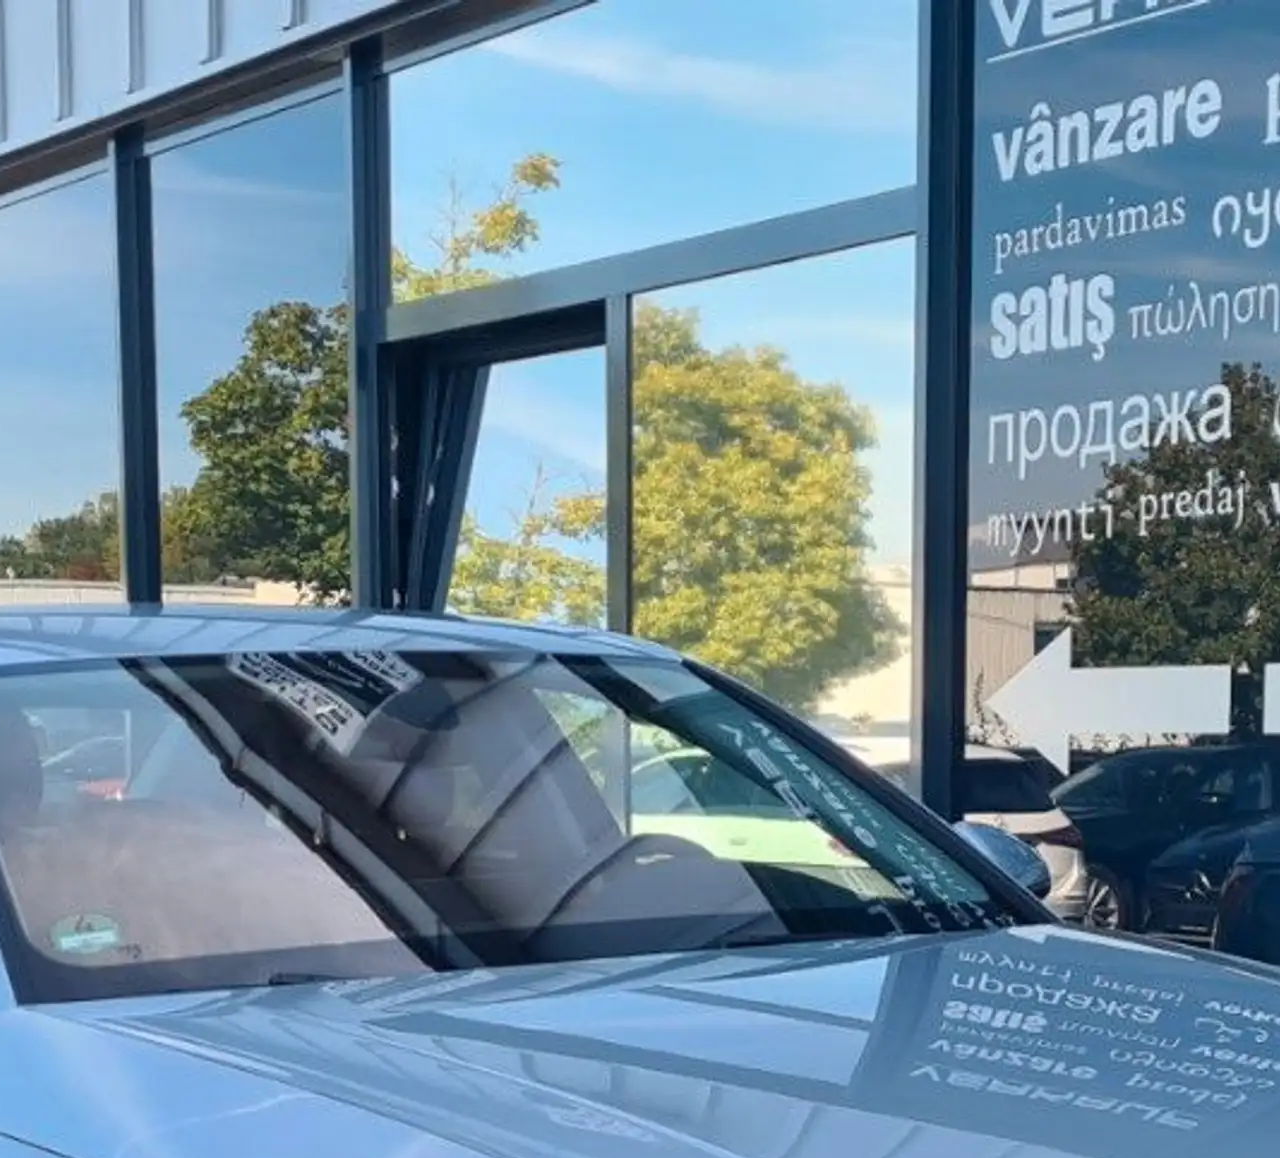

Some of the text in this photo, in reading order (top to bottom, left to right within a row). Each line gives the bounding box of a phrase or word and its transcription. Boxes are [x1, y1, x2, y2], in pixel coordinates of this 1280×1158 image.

[992, 78, 1222, 181] vânzare
[993, 196, 1187, 274] pardavimas
[989, 272, 1116, 361] satış
[1128, 281, 1280, 341] πώληση
[987, 383, 1232, 481] продажа
[986, 493, 1116, 557] myynti
[1138, 470, 1247, 531] predaj
